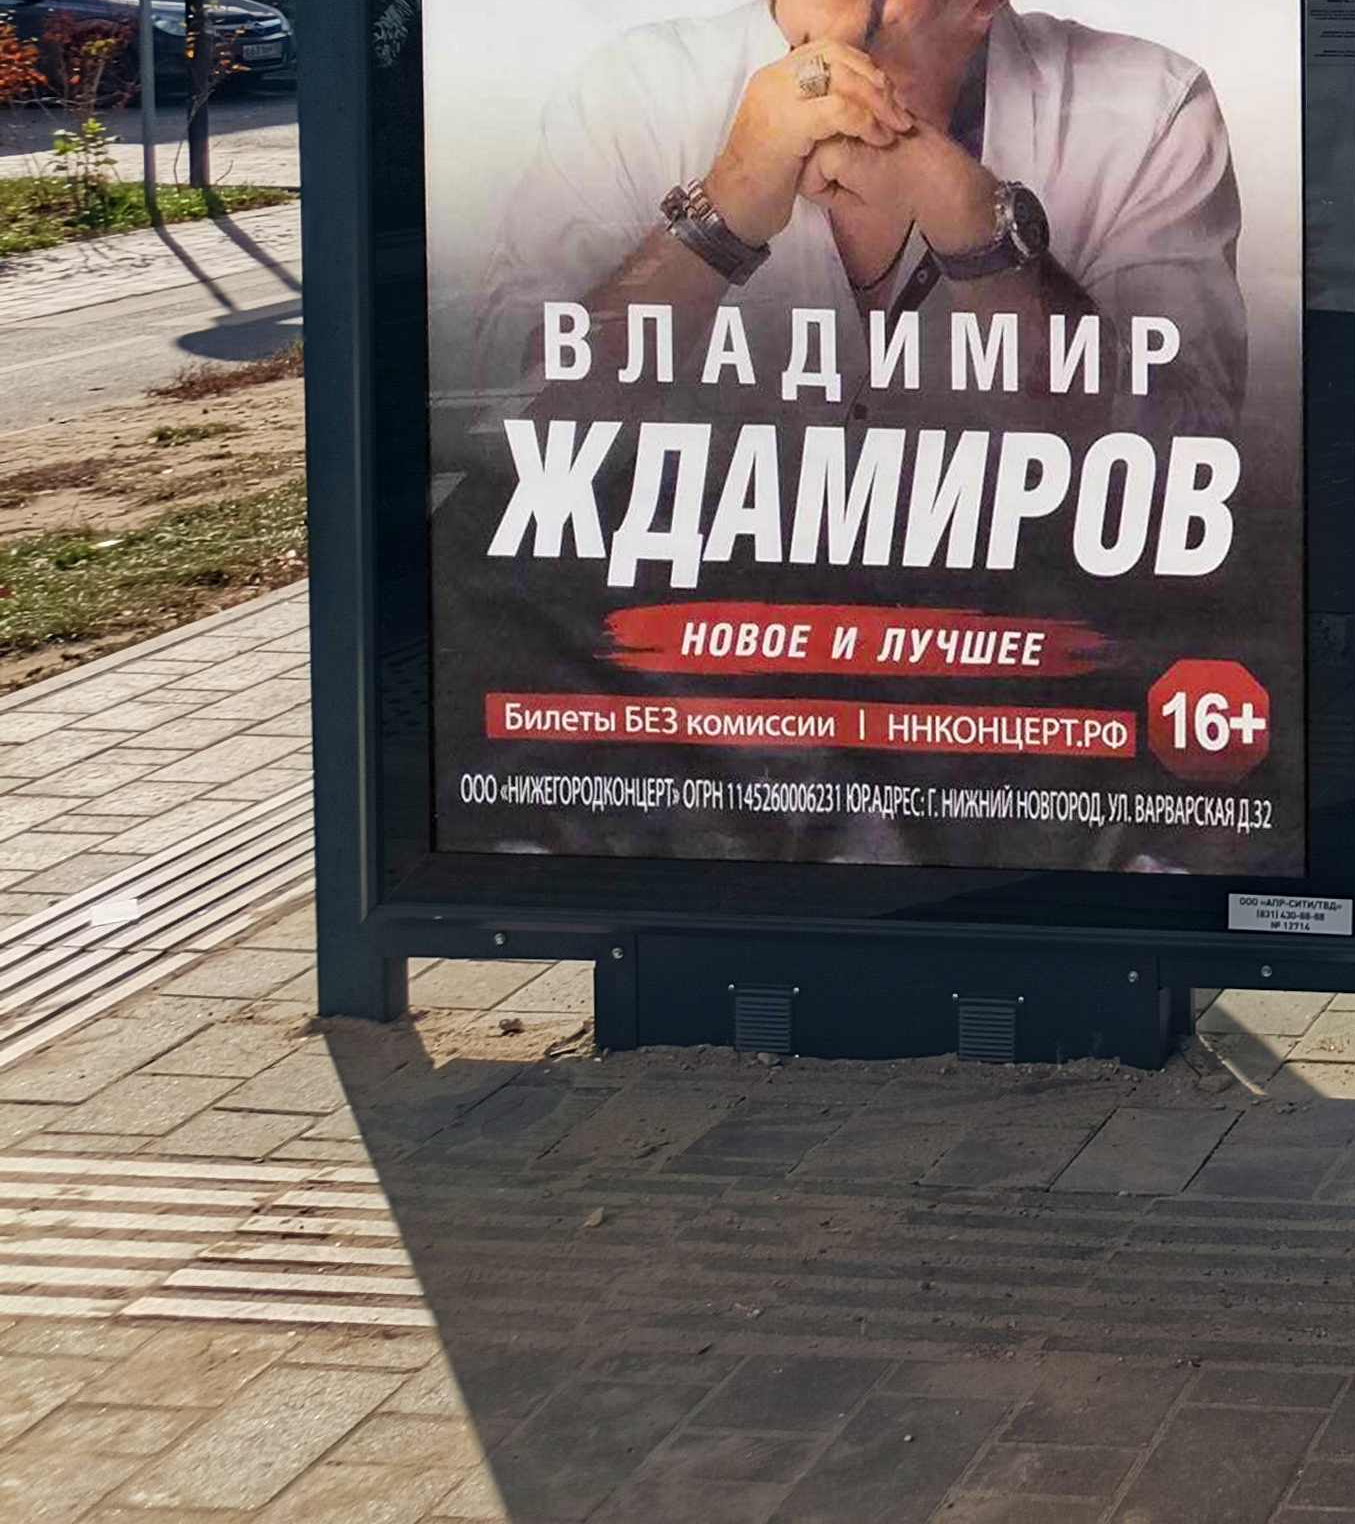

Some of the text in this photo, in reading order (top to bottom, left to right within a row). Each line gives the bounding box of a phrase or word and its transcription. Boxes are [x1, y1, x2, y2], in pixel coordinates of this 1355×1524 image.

[543, 301, 1182, 403] ВЛАДИМИР
[486, 418, 1242, 590] ЖДАМИРОВ
[680, 621, 1045, 666] НОВОЕ И ЛУЧШЕЕ
[504, 702, 835, 739] Билеты БЕЗ комиссии
[888, 713, 1128, 754] ННКОНЦЕРТ.РФ
[1161, 692, 1267, 752] 16+
[460, 774, 497, 803] ООО
[500, 775, 680, 812] «НИЖЕГОРОДКОНЦЕРТ»
[683, 779, 723, 809] ОГРН
[727, 781, 841, 812] 1145260006231
[942, 785, 1013, 819] НИЖНИЙ
[1017, 791, 1105, 827] НОВГОРОД,
[1108, 796, 1132, 823] УЛ.
[1135, 796, 1235, 826] ВАРВАРСКАЯ
[1237, 800, 1272, 834] Д.32
[1240, 897, 1258, 906] ООО
[1256, 909, 1279, 919] (831)
